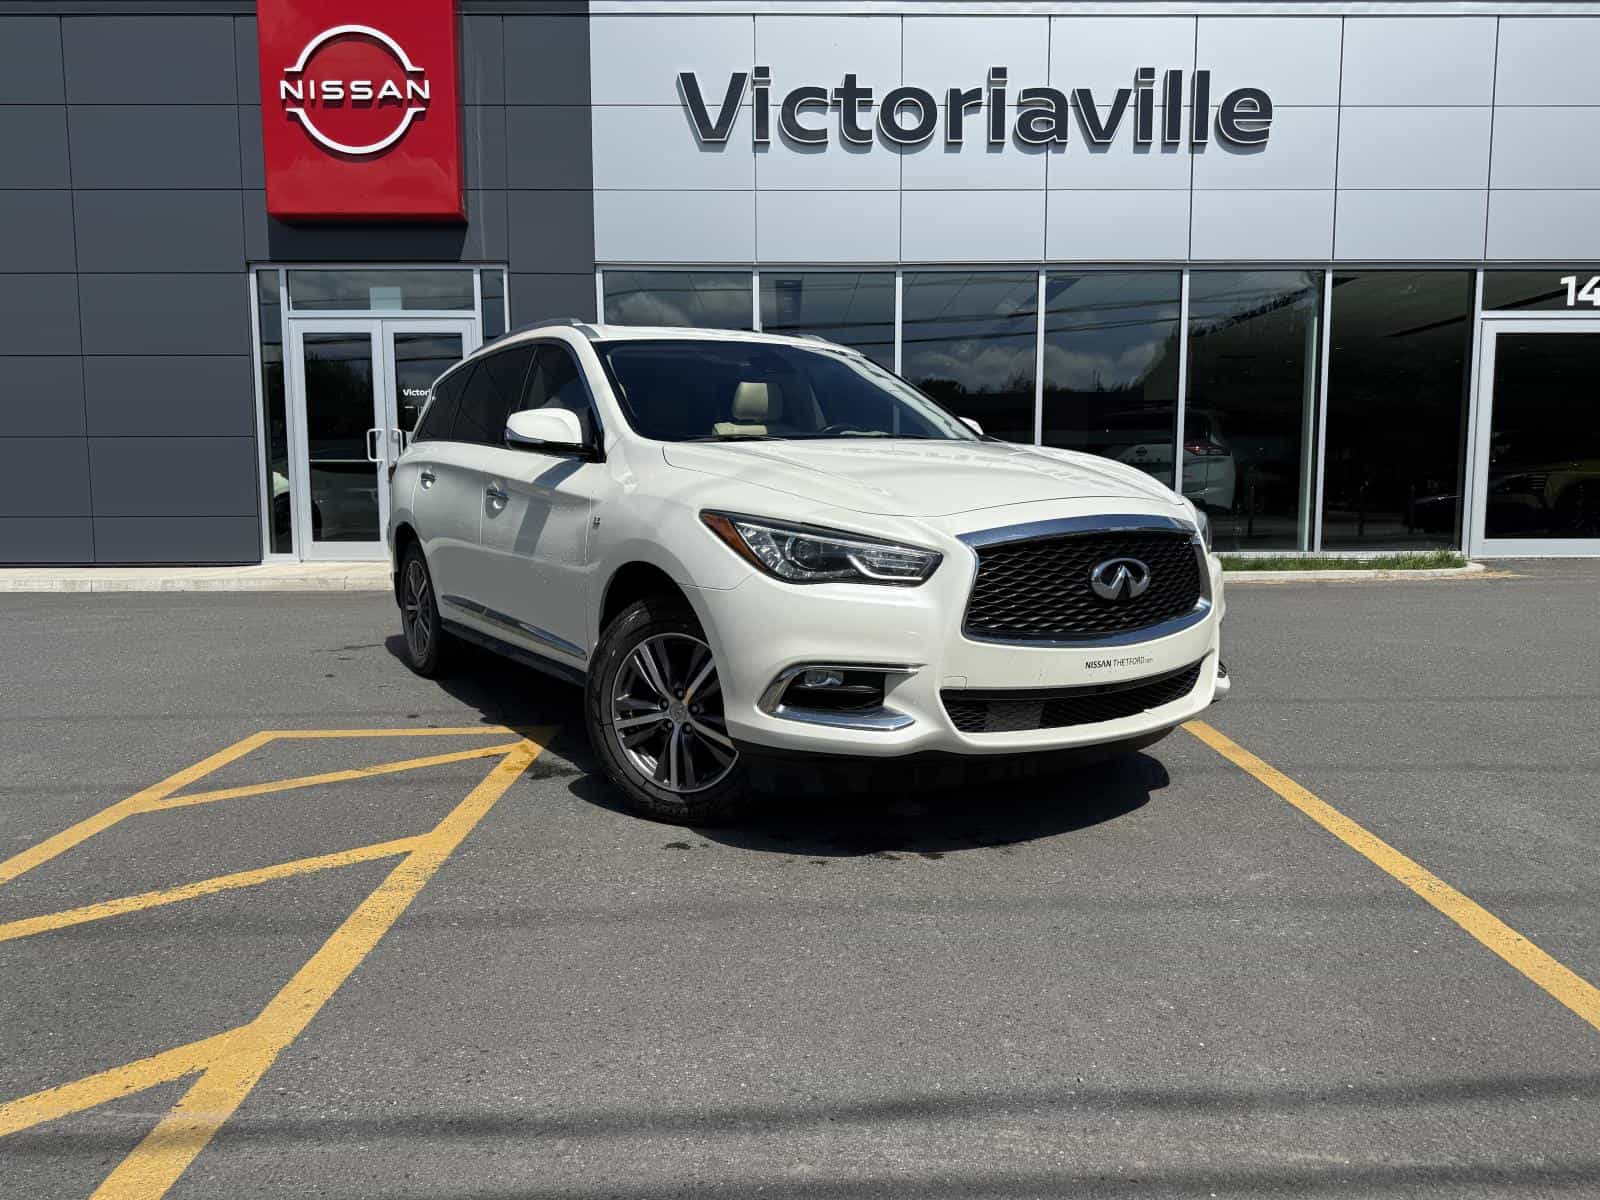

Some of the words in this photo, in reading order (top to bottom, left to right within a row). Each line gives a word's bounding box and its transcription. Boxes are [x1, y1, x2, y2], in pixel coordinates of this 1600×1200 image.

[280, 80, 431, 99] NISSAN
[677, 66, 1273, 145] Victoriaville
[1085, 659, 1112, 669] NISSAN
